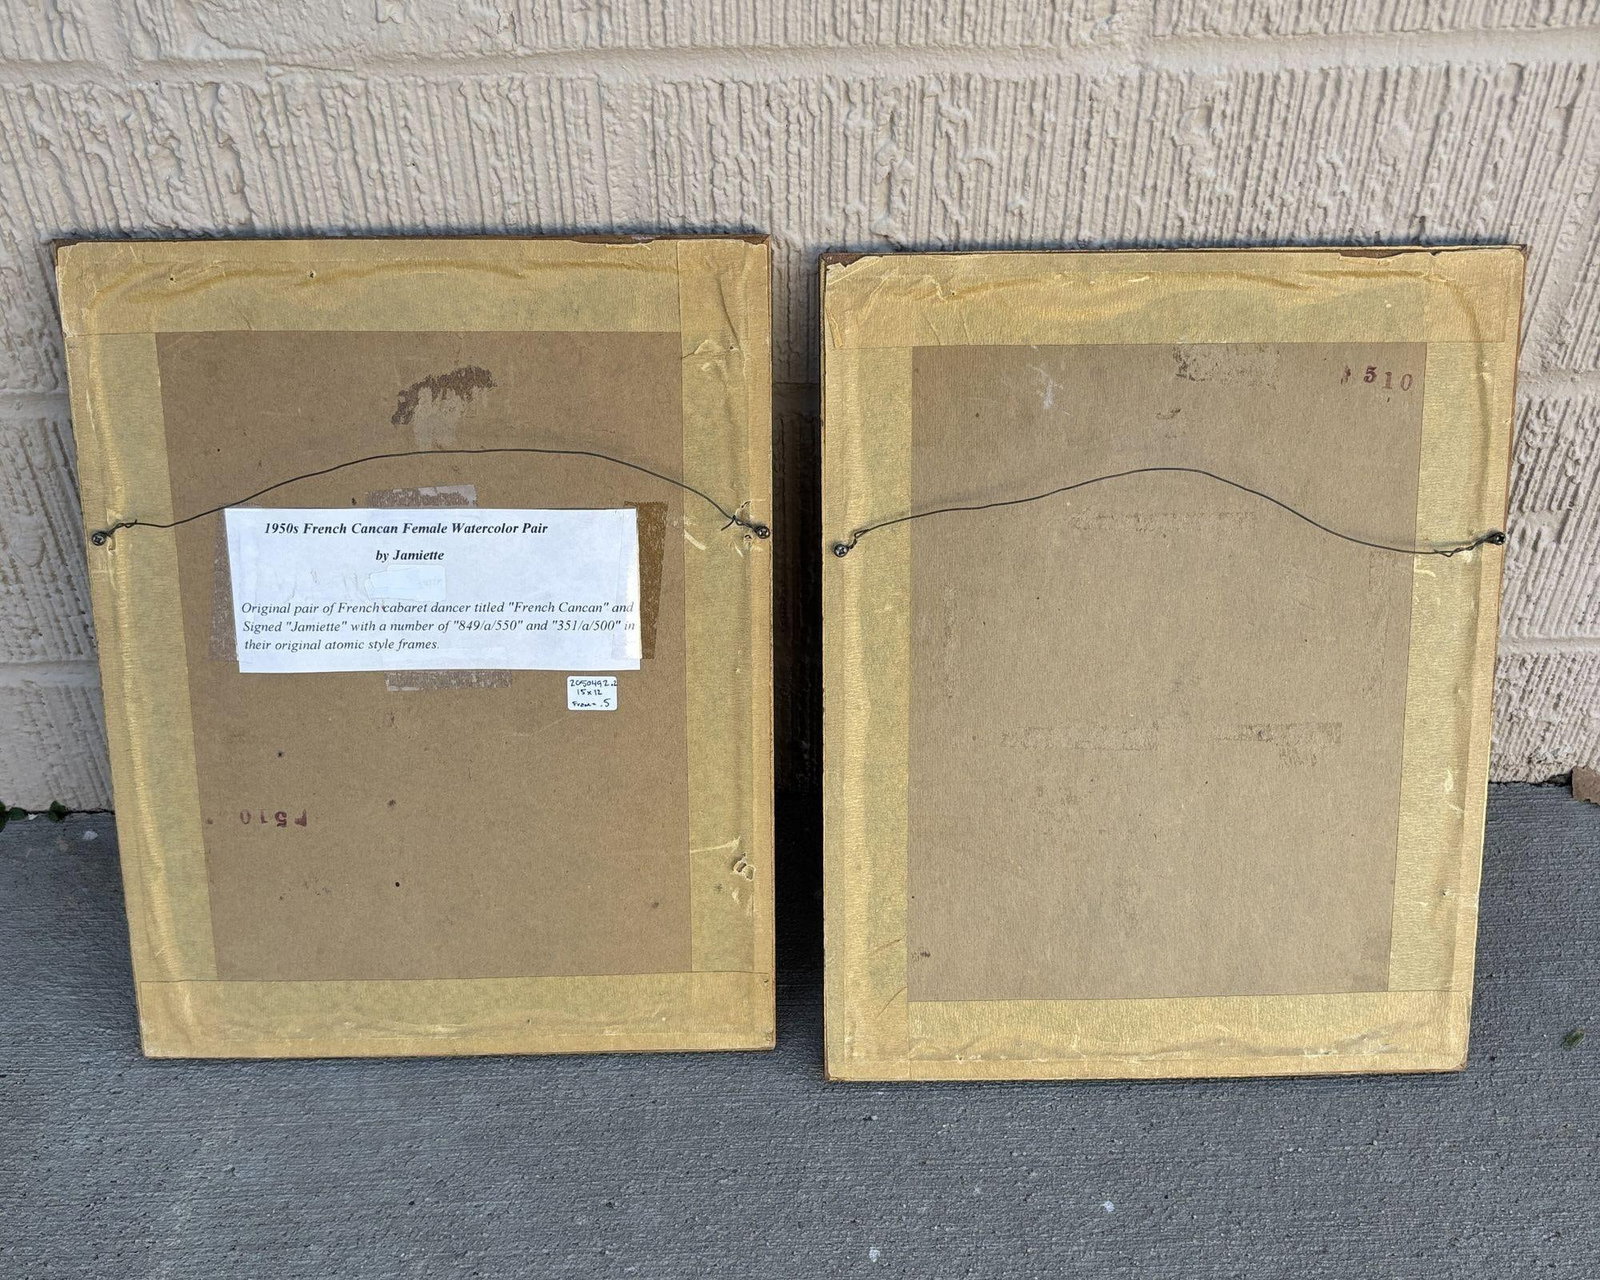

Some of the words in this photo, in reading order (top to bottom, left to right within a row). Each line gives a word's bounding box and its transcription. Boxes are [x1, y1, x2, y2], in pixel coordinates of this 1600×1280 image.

[264, 523, 299, 534] 1950s
[303, 523, 347, 534] French
[351, 523, 398, 534] Cancan
[402, 523, 448, 534] Female
[452, 523, 518, 534] Watercolor
[522, 523, 548, 534] Pair
[375, 550, 389, 563] by
[392, 549, 445, 561] Jamiette
[241, 602, 290, 616] Original
[293, 604, 319, 616] pair
[322, 602, 336, 616] of
[337, 602, 380, 613] French
[383, 602, 427, 613] cabaret
[430, 602, 471, 613] dancer
[474, 602, 504, 613] titled
[508, 602, 555, 613] "French
[558, 602, 609, 613] Cancan"
[611, 602, 634, 613] and
[243, 621, 282, 634] Signed
[285, 621, 348, 633] "Jamiette"
[351, 621, 376, 632] with
[379, 624, 387, 632] a
[390, 620, 434, 632] number
[437, 620, 450, 633] of
[453, 620, 523, 631] "849/a/550"
[526, 620, 548, 631] and
[552, 620, 621, 631] "351/a/500"
[624, 621, 635, 631] in
[244, 639, 272, 650] their
[275, 639, 321, 653] original
[324, 639, 365, 650] atomic
[368, 638, 395, 651] style
[396, 638, 440, 652] frames.
